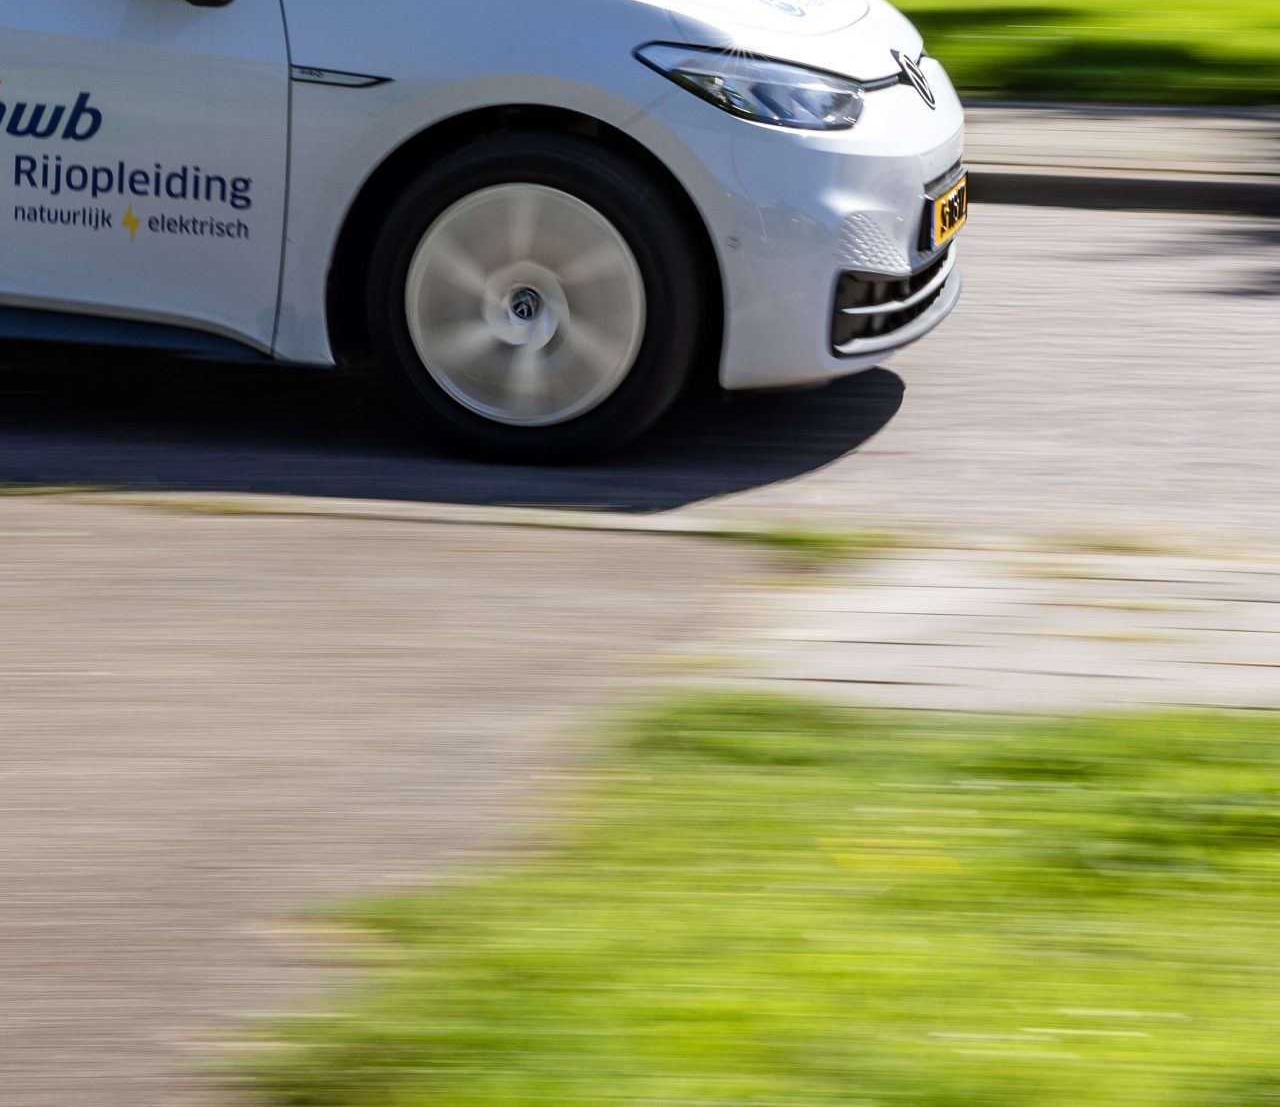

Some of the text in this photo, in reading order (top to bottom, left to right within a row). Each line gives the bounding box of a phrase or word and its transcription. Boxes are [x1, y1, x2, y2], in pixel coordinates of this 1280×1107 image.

[14, 154, 253, 210] Rijopleiding
[14, 204, 250, 240] natuurlijk elektrisch
